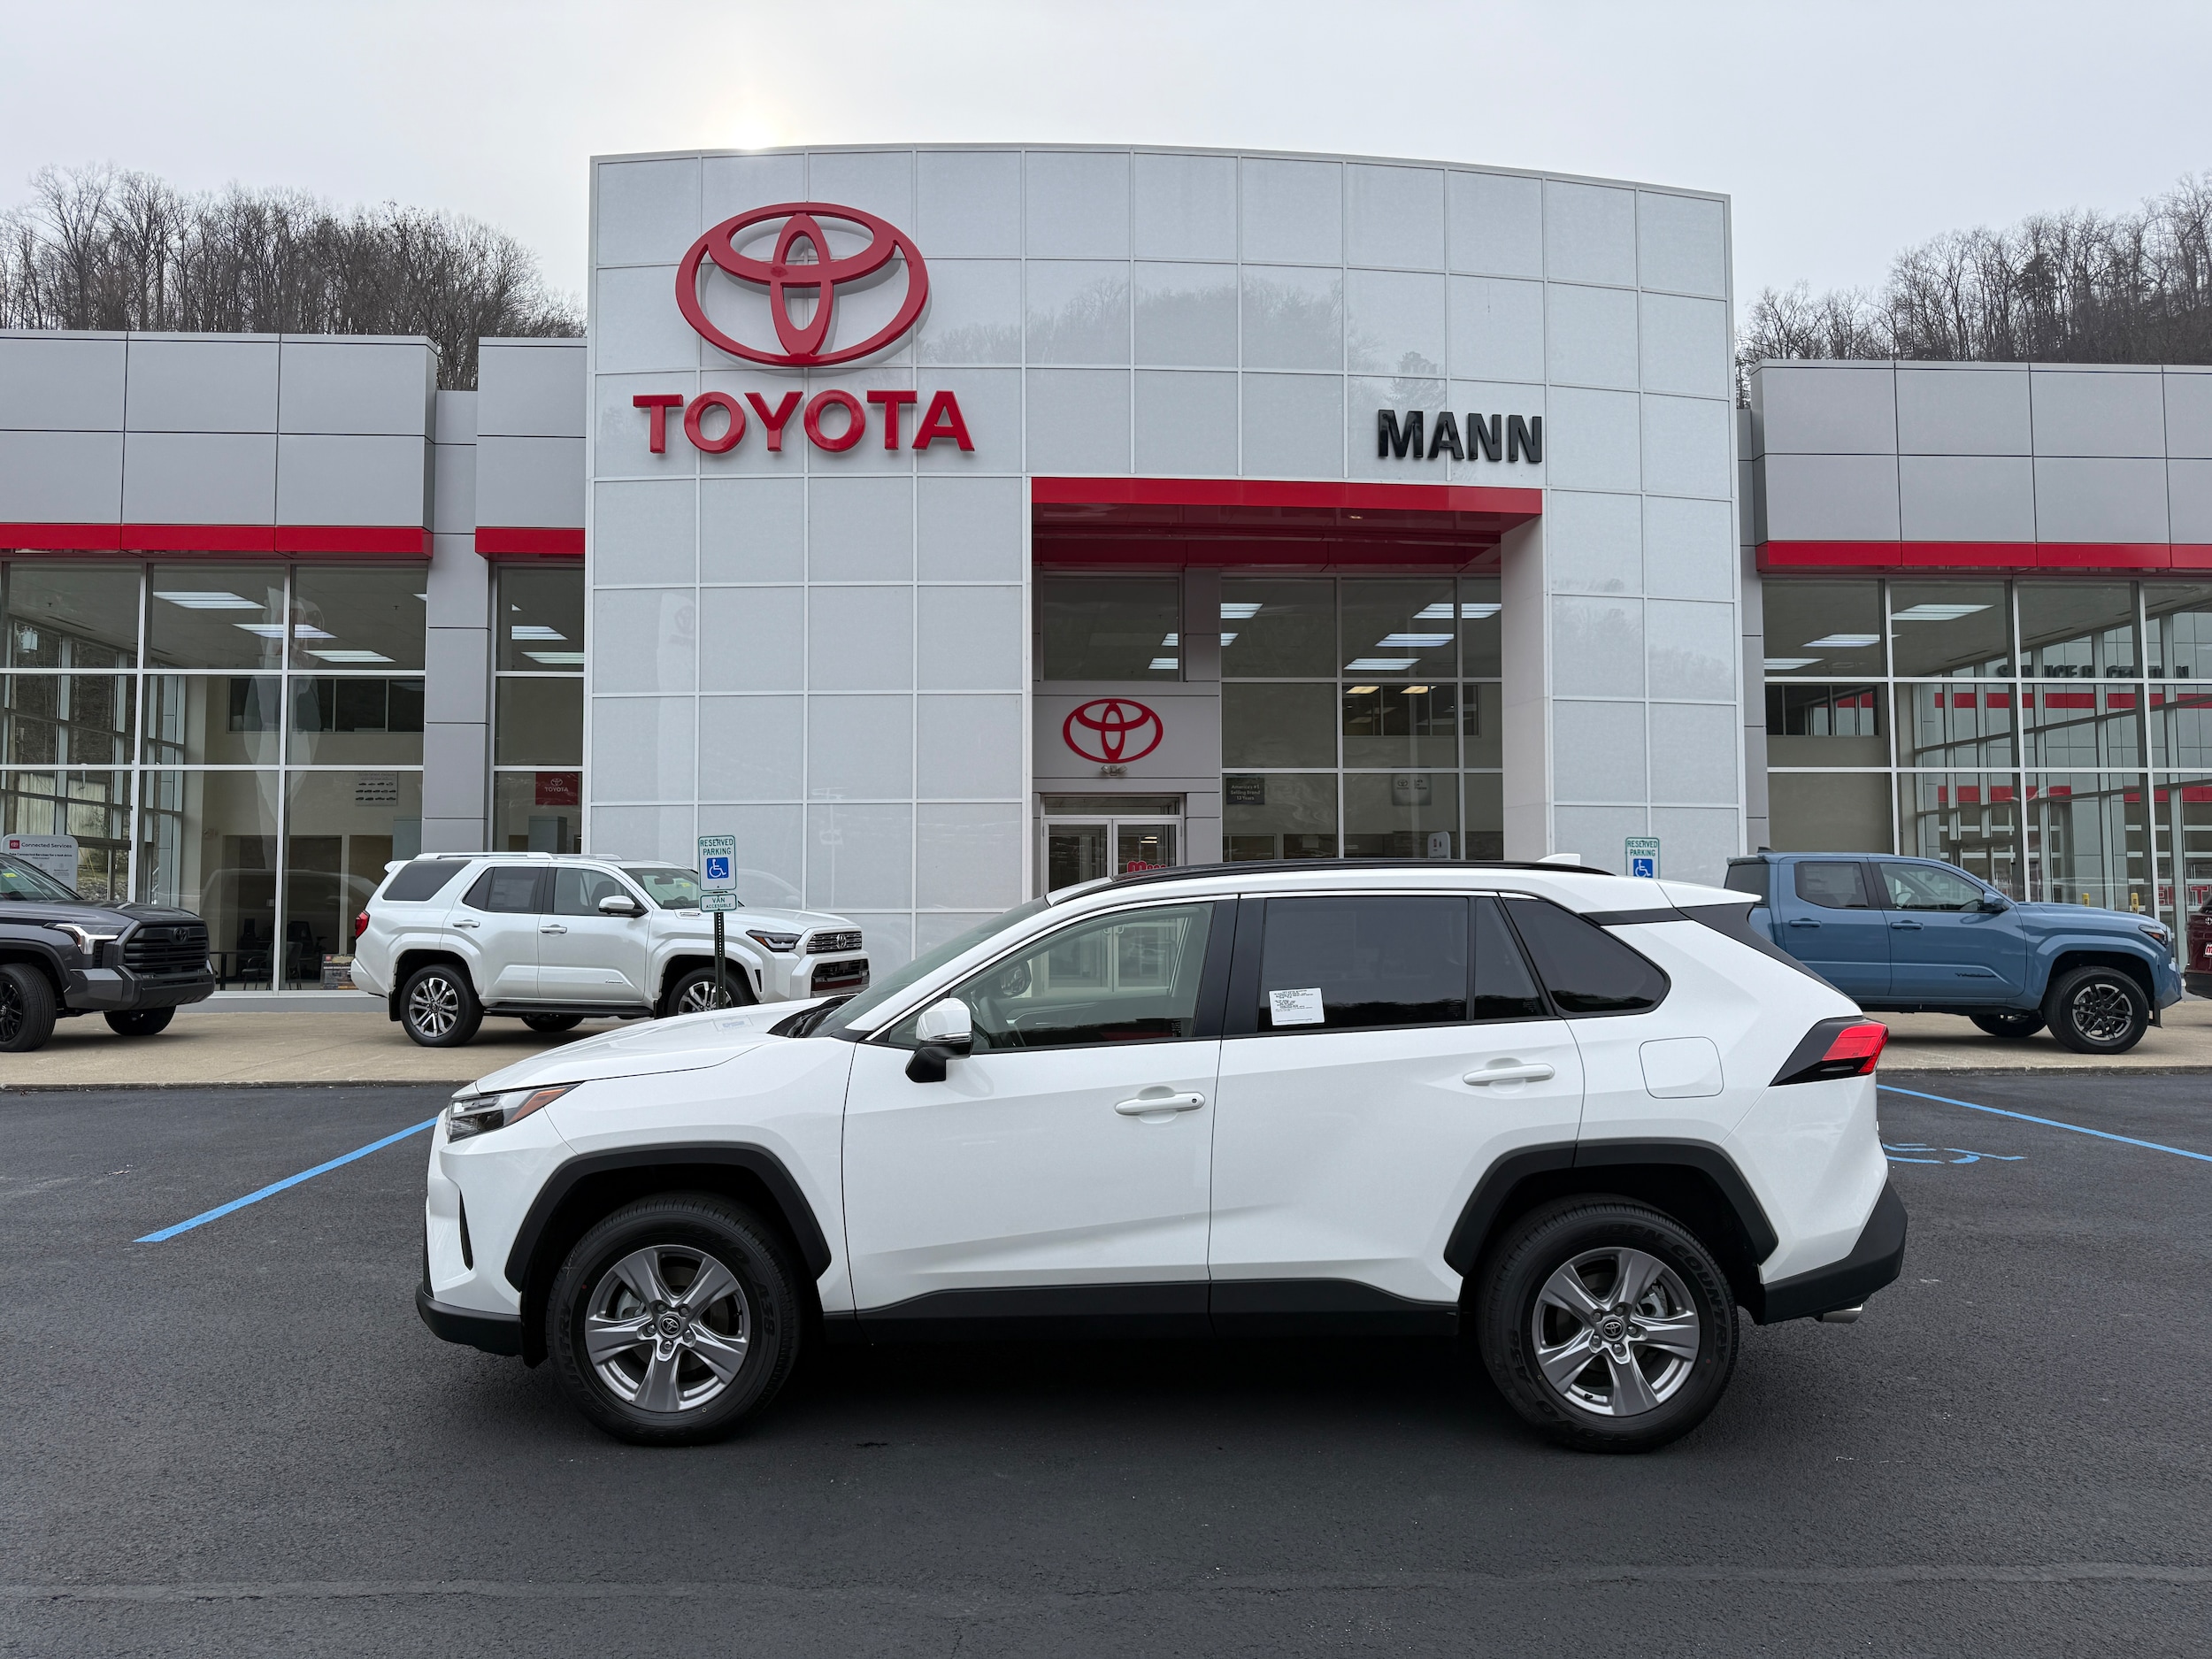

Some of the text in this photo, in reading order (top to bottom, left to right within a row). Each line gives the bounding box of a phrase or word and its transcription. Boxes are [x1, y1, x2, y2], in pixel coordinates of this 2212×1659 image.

[633, 389, 975, 454] TOYOTA
[1378, 410, 1542, 463] MANN
[700, 838, 733, 847] RESERVED
